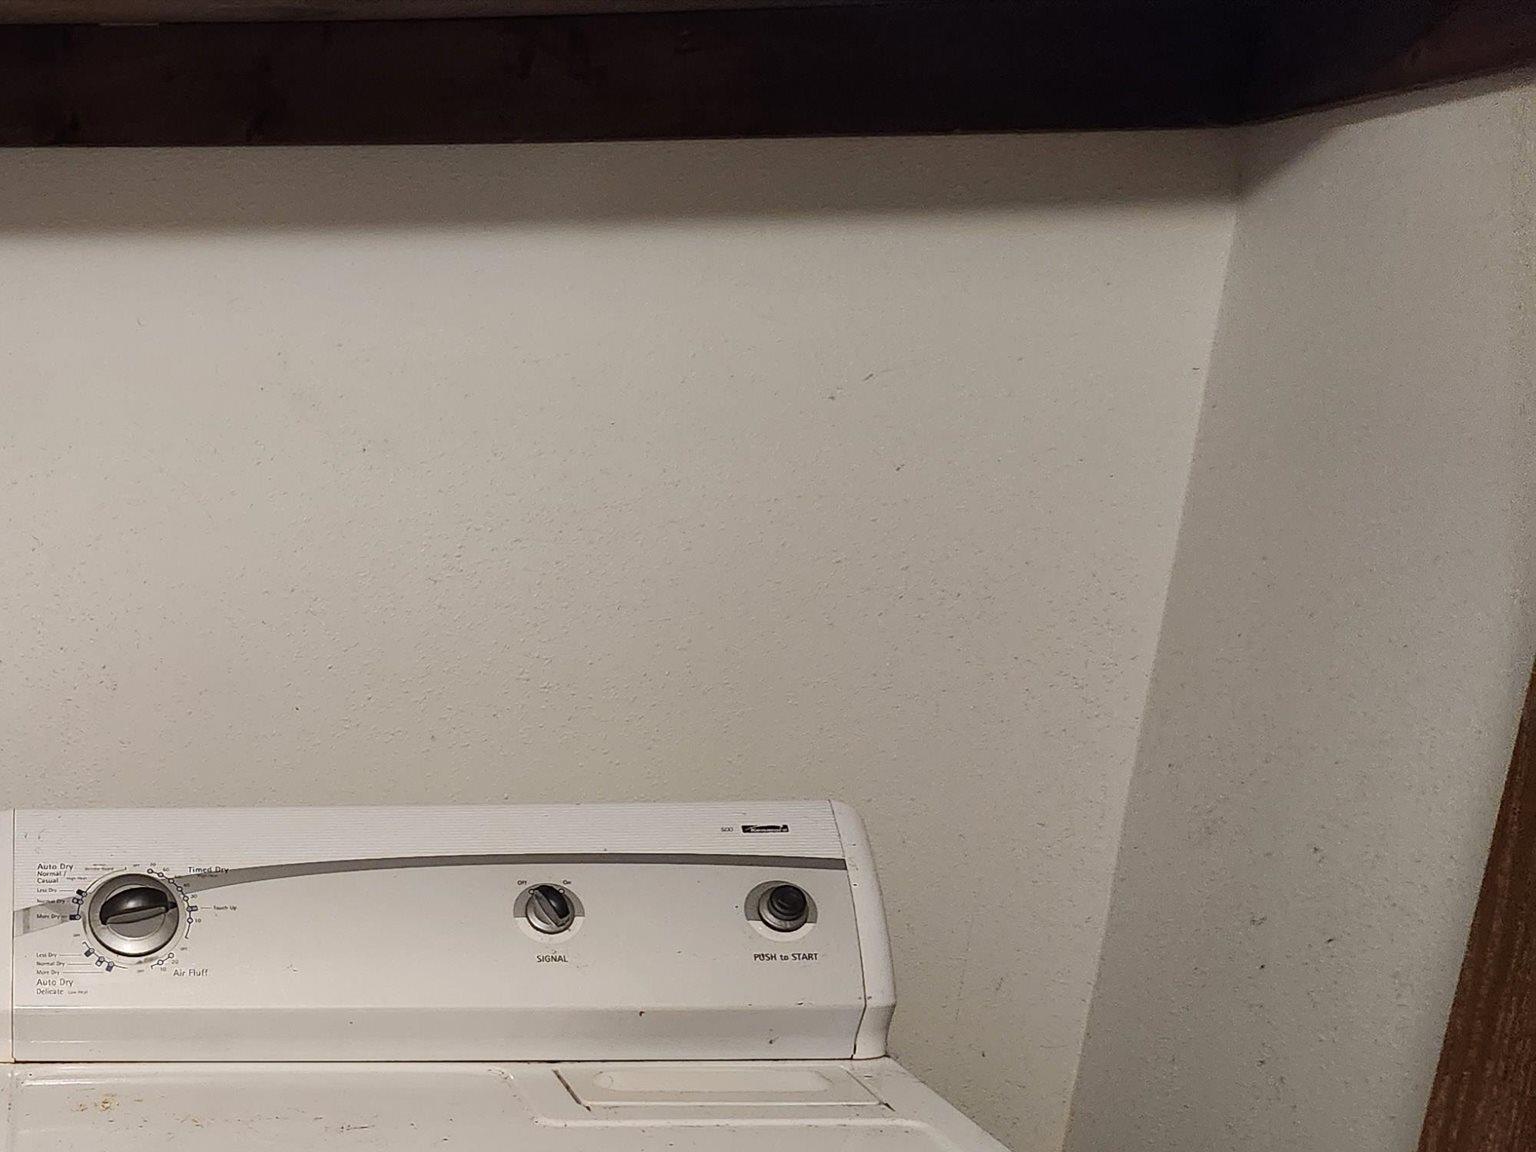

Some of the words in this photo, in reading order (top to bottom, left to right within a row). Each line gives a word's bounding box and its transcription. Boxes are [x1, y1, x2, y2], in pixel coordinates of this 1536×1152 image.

[59, 863, 74, 872] Dry
[188, 866, 213, 874] Timed
[215, 866, 229, 875] Dry
[536, 954, 569, 964] SIGNAL
[753, 953, 778, 962] PUSH
[779, 953, 789, 961] to
[791, 953, 819, 962] START
[173, 969, 186, 977] Air
[188, 968, 209, 977] Fluff
[36, 978, 57, 986] Auto
[59, 978, 74, 987] Dry
